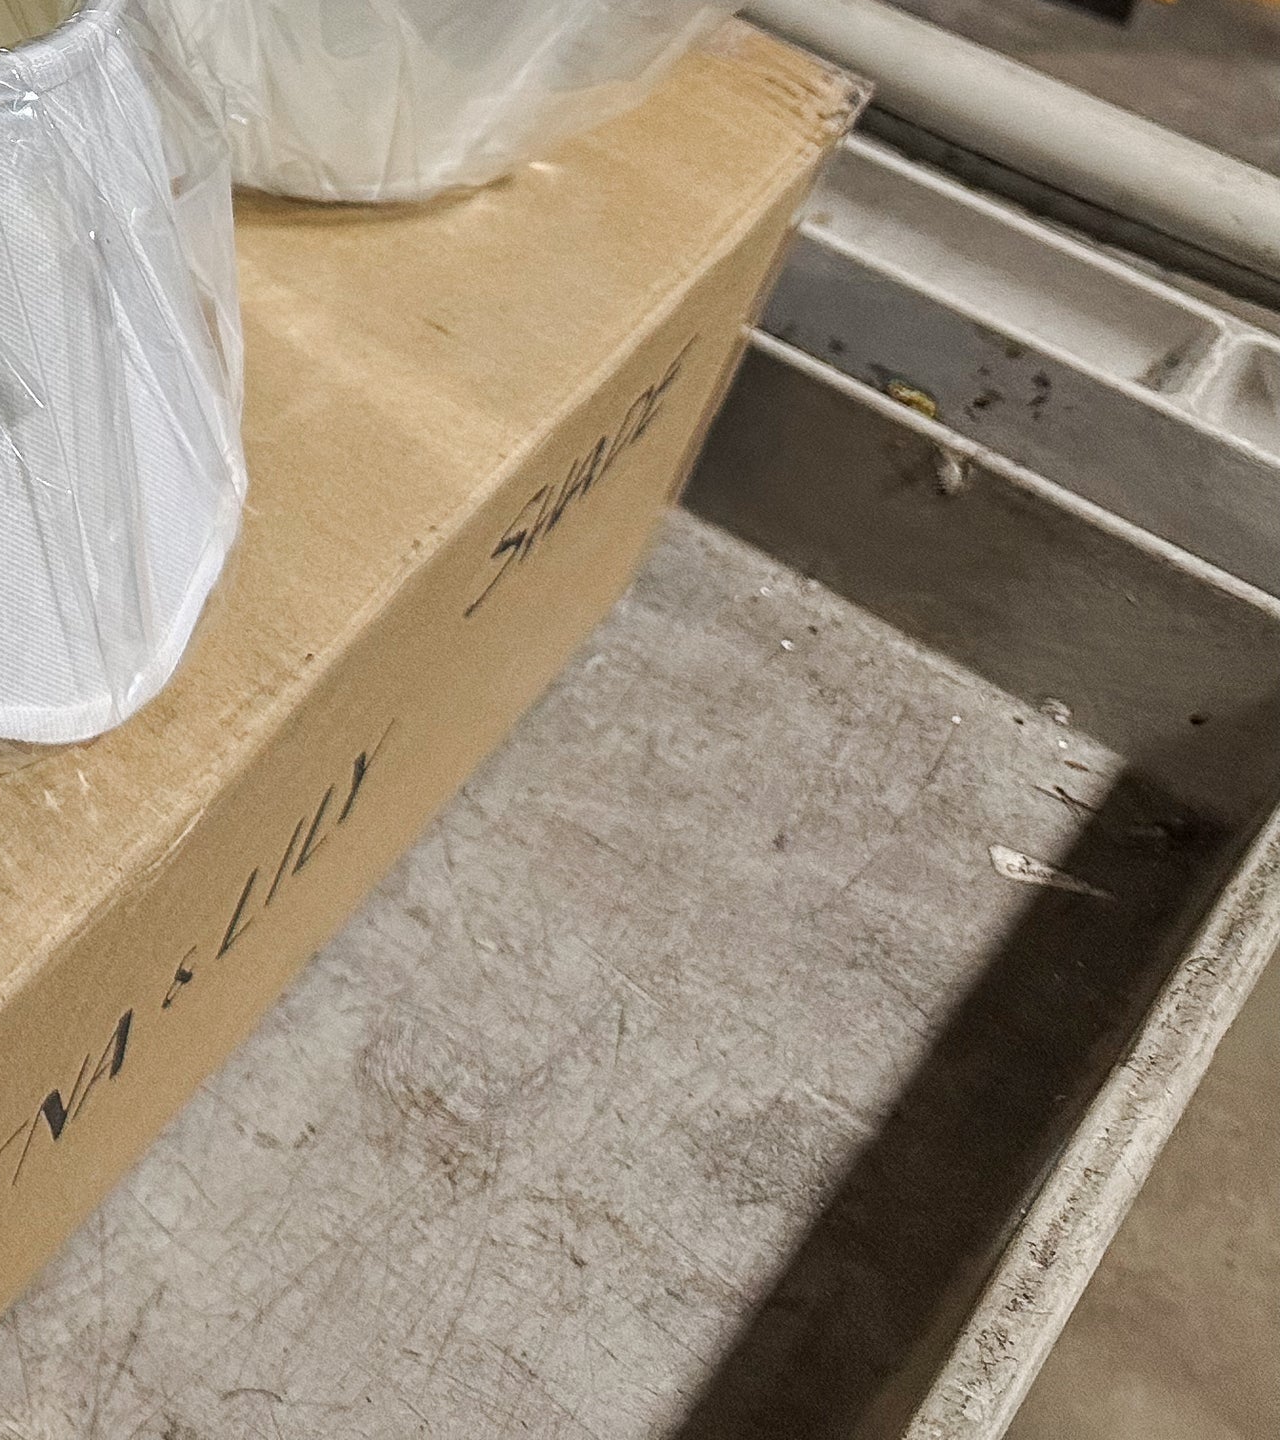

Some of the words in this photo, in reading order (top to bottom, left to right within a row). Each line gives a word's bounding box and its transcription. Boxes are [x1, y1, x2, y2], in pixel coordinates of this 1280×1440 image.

[161, 945, 197, 1009] &
[215, 717, 395, 960] LILY
[464, 333, 701, 618] SHADE
